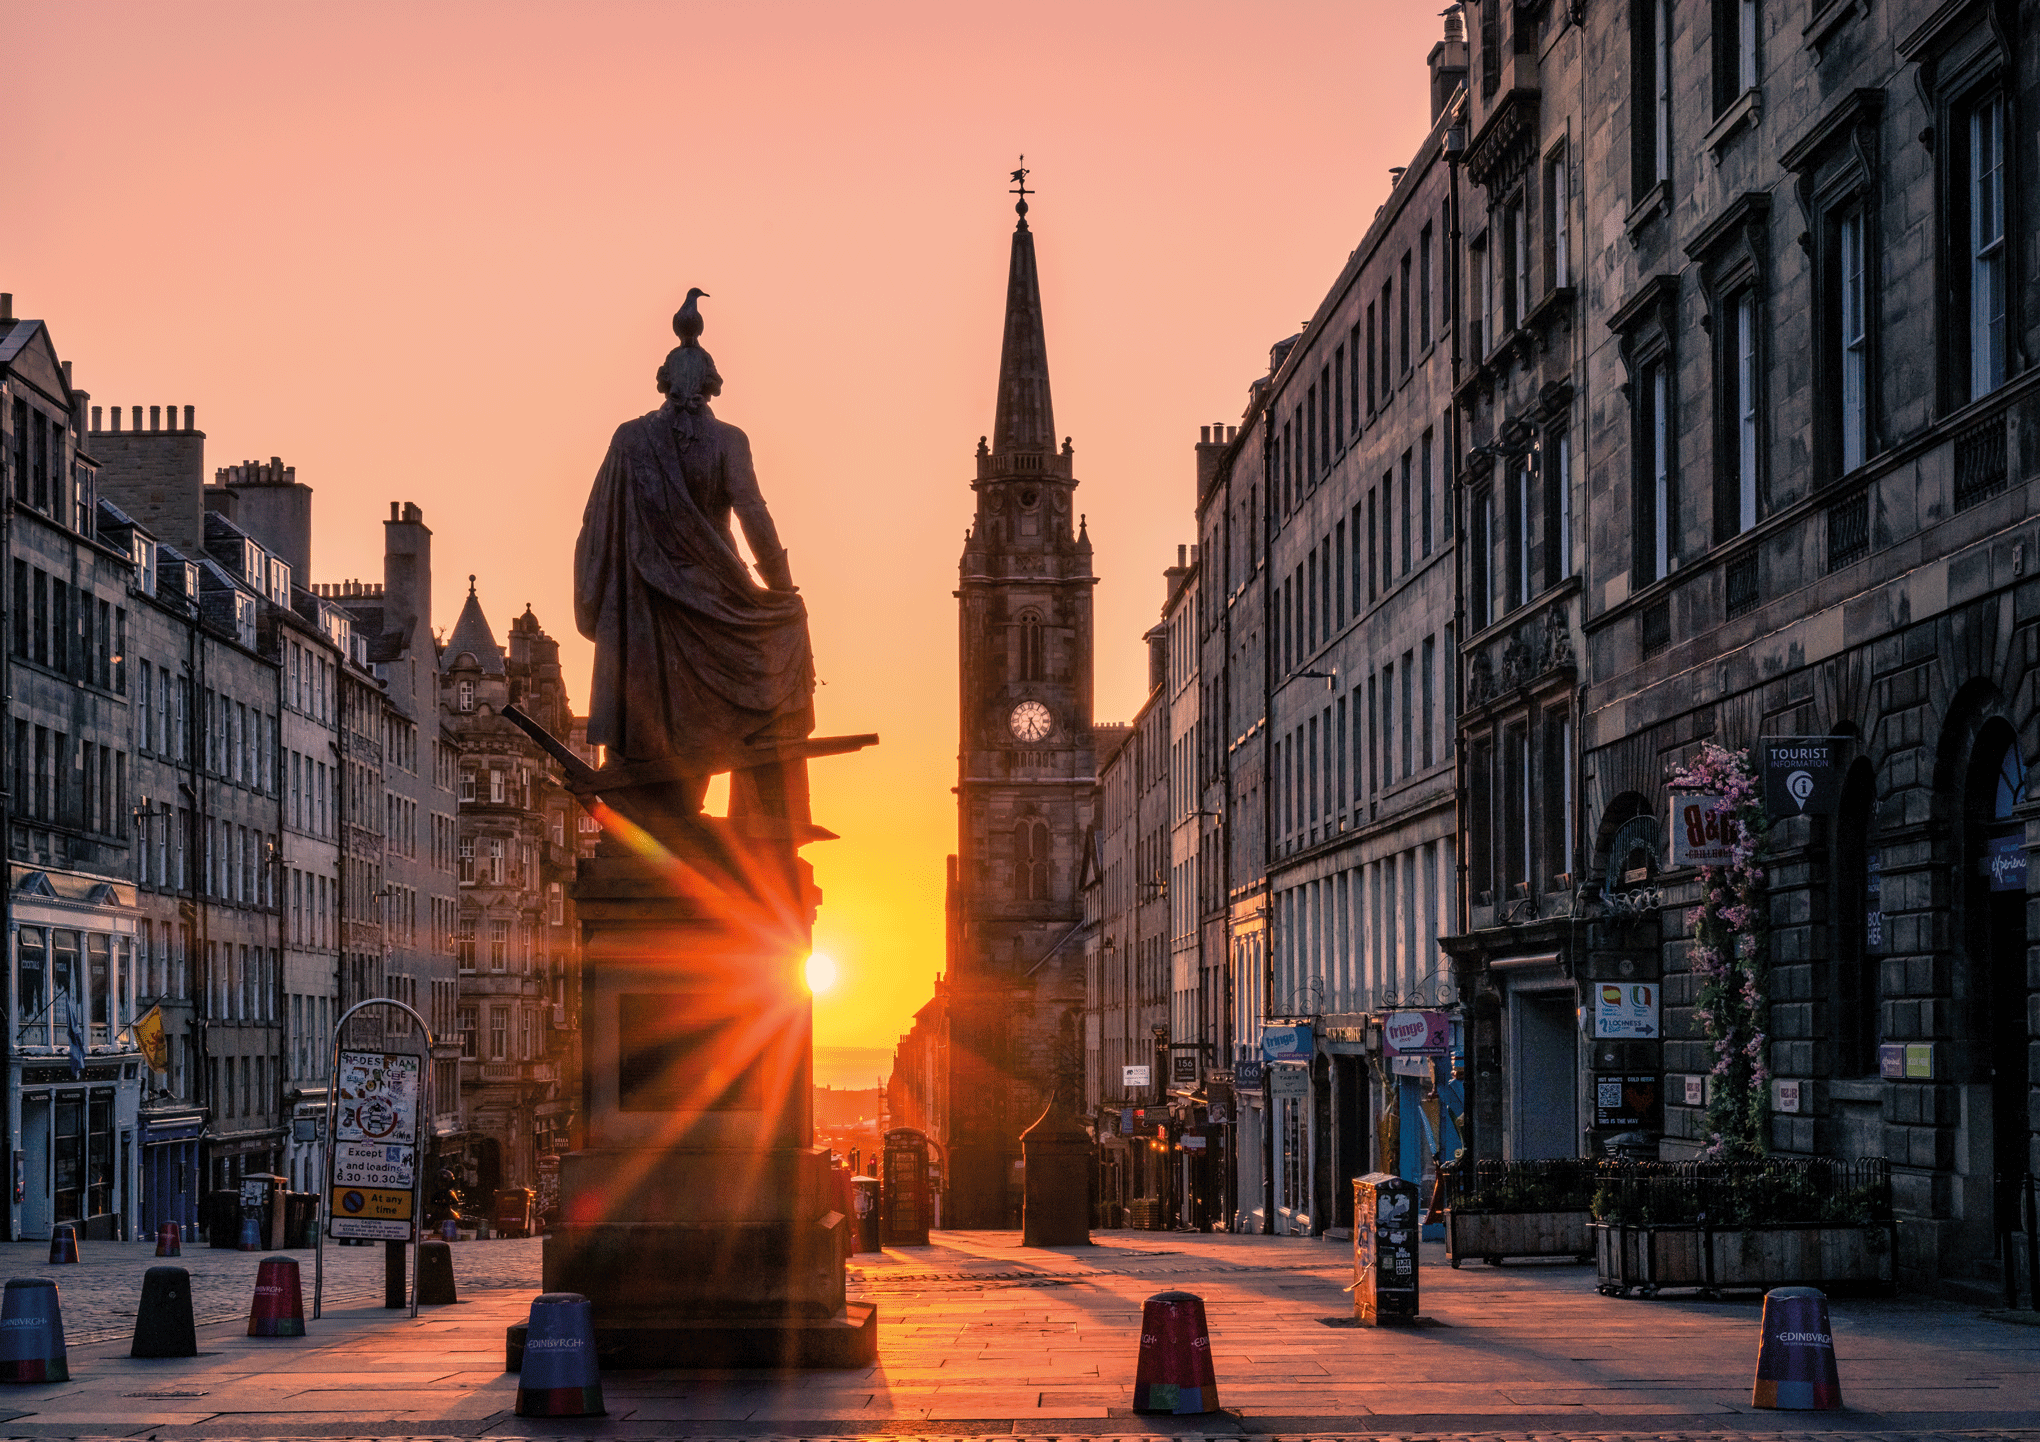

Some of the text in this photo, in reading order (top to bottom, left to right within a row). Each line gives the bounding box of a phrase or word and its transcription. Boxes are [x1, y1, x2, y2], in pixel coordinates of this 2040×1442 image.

[1770, 748, 1829, 760] TOURIST
[1771, 759, 1829, 768] INFORMATION
[1389, 1022, 1424, 1040] fringe
[1265, 1033, 1295, 1048] fringe
[1239, 1066, 1258, 1077] 166
[348, 1147, 382, 1158] Except
[346, 1162, 364, 1170] and
[371, 1194, 403, 1204] At any
[376, 1205, 397, 1214] time
